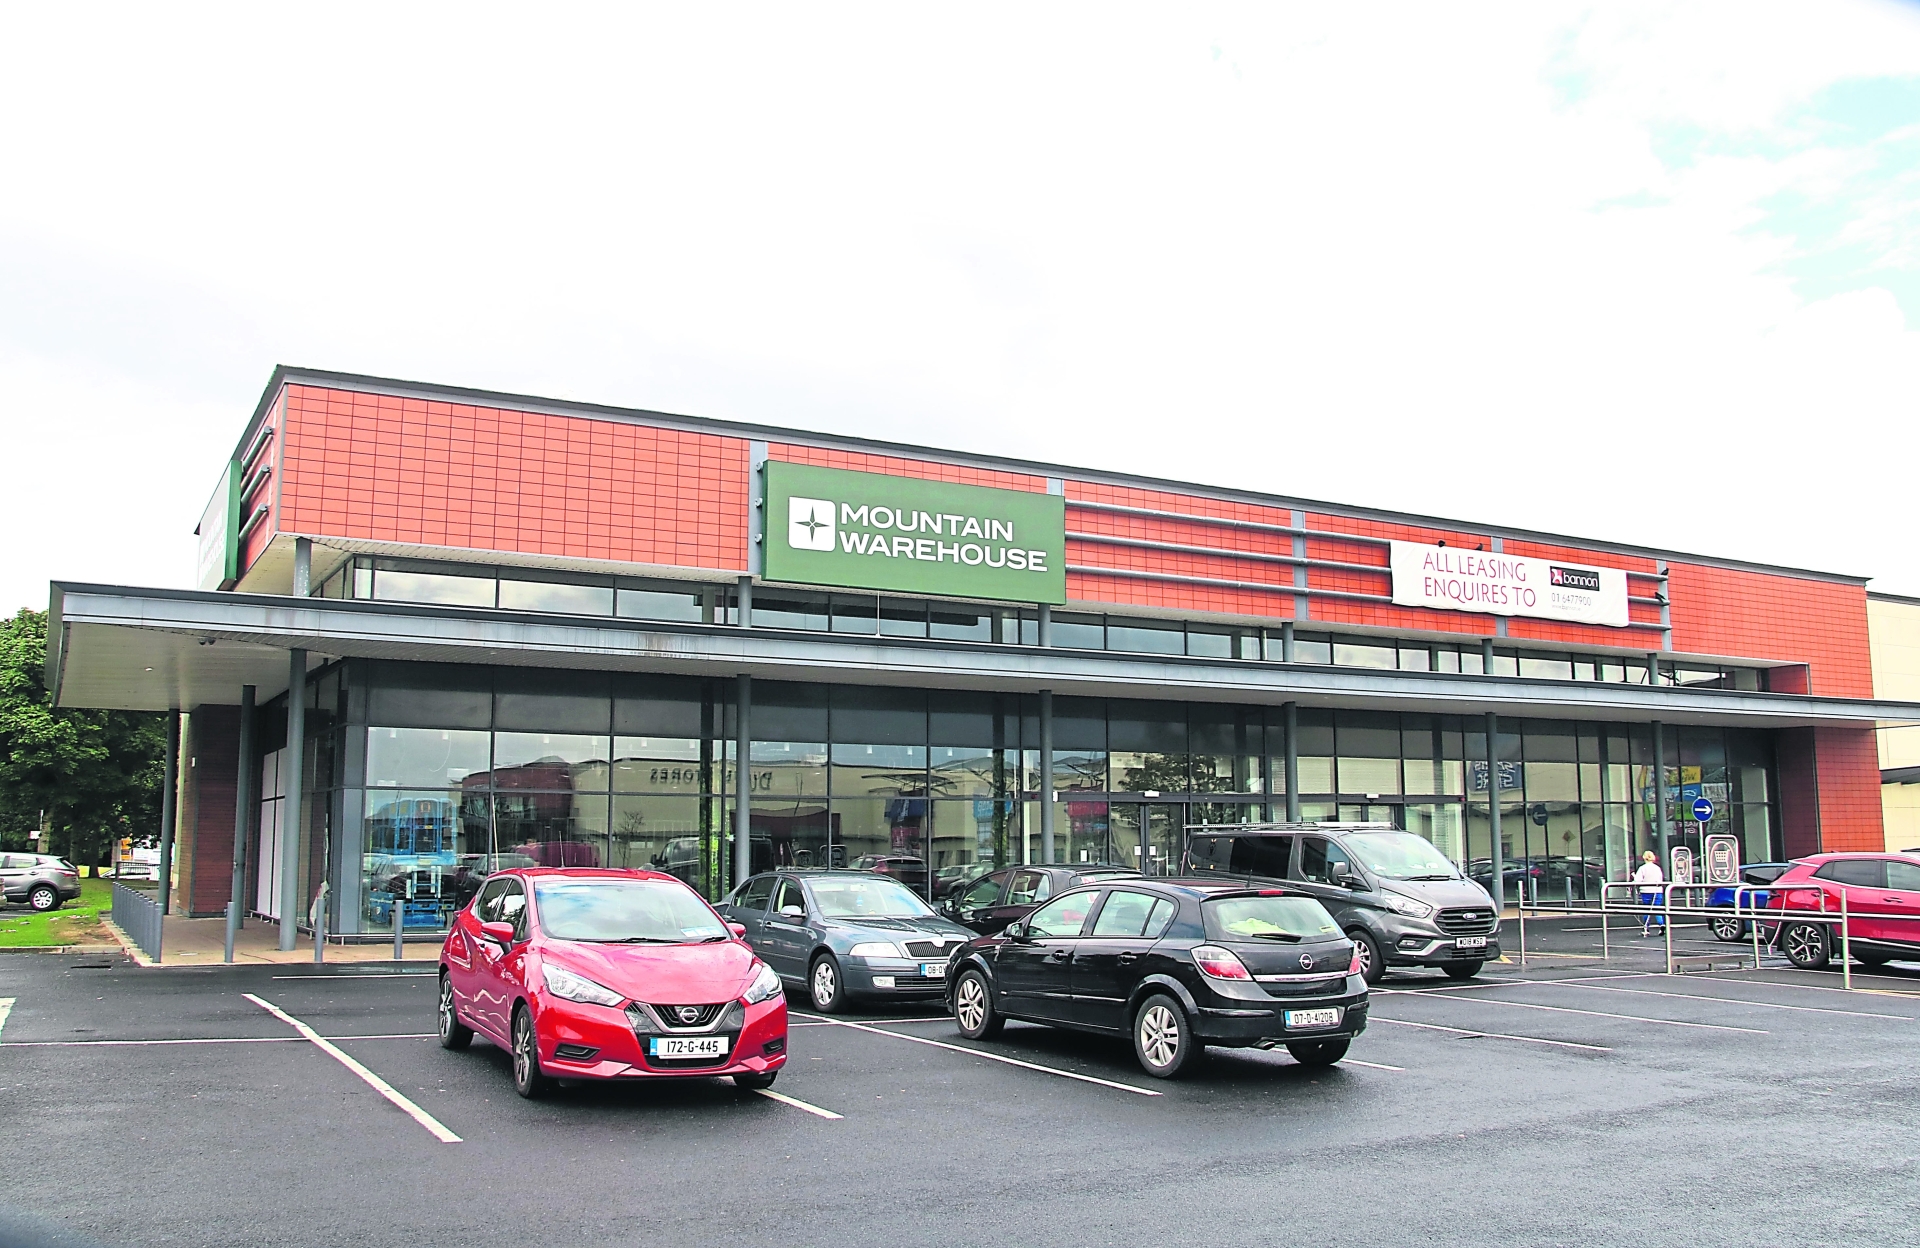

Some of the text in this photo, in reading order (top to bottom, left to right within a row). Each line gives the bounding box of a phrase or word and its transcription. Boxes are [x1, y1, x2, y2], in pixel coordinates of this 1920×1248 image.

[840, 502, 1014, 542] MOUNTAIN
[839, 530, 1049, 572] WAREHOUSE
[1423, 552, 1526, 582] ALL LEASING
[1563, 571, 1599, 588] bannon
[1424, 577, 1536, 607] ENQUIRES TO
[1551, 592, 1592, 606] 01 6477900
[667, 1040, 719, 1053] 172-G-445
